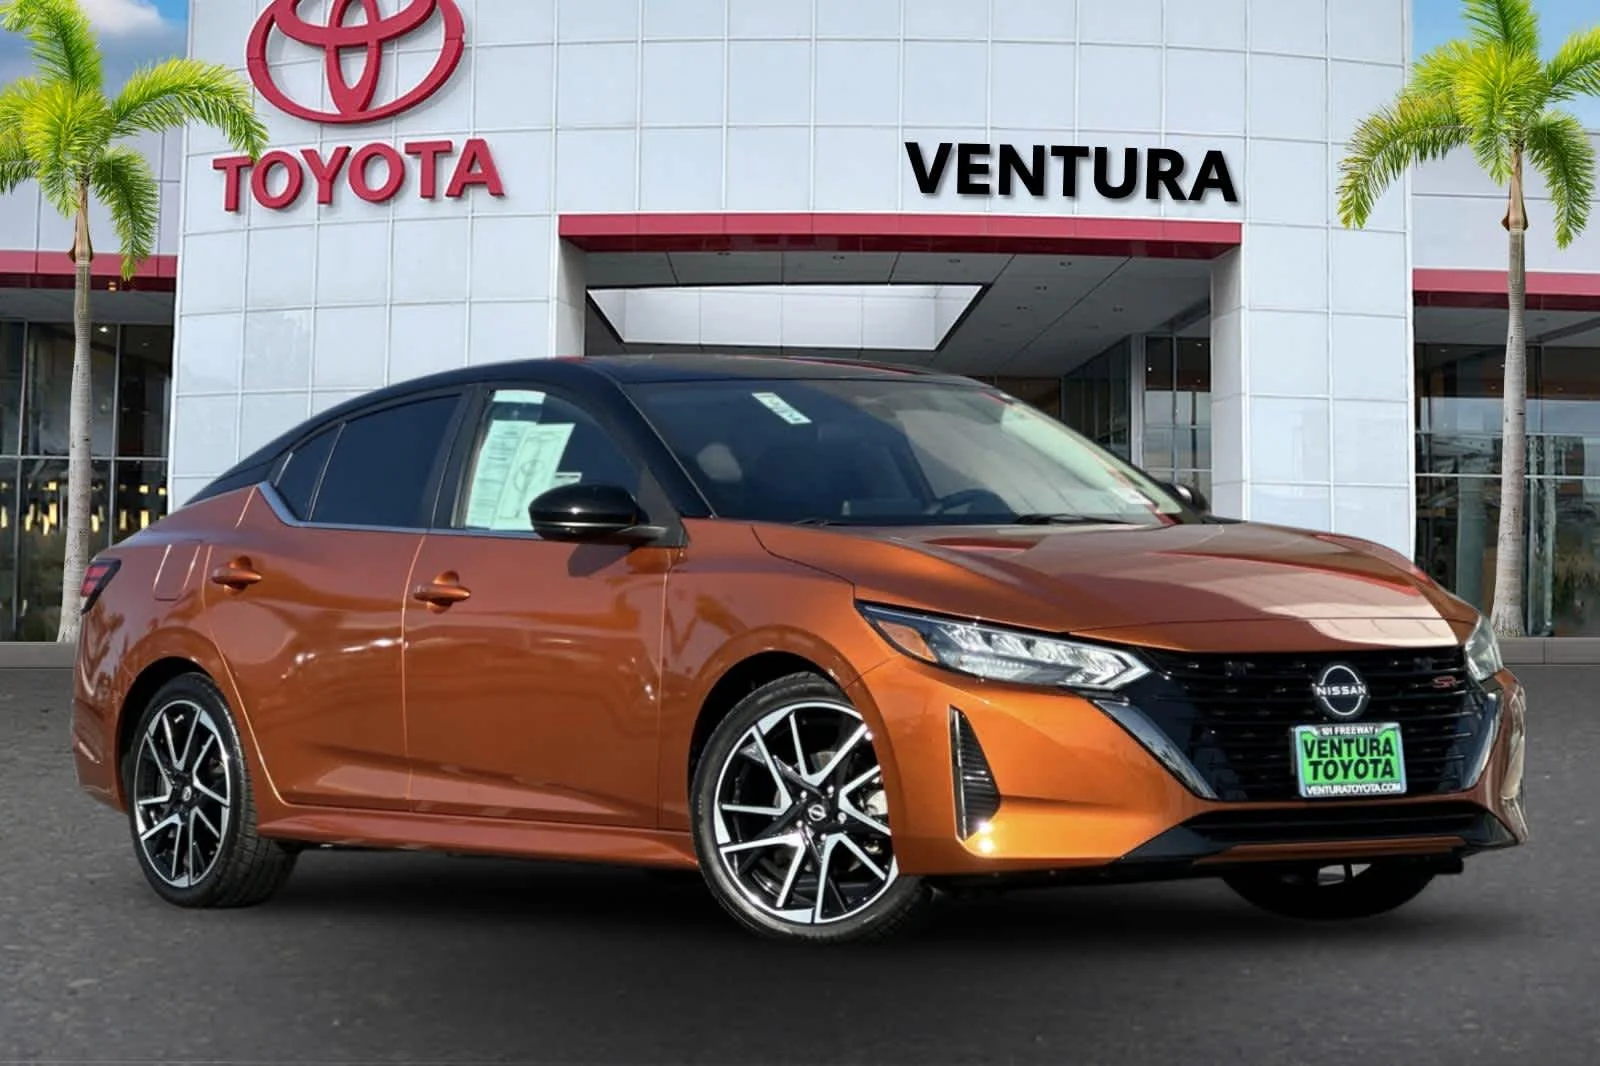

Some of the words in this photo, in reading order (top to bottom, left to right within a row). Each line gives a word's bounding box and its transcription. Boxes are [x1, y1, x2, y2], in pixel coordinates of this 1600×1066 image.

[213, 138, 505, 212] TOYOTA
[904, 141, 1239, 203] VENTURA
[1315, 684, 1367, 696] NISSAN
[1334, 726, 1375, 736] FREEWAY
[1303, 737, 1394, 759] VENTURA
[1309, 758, 1395, 781] TOYOTA
[1306, 783, 1402, 795] VENTURATOYOTA.COM
